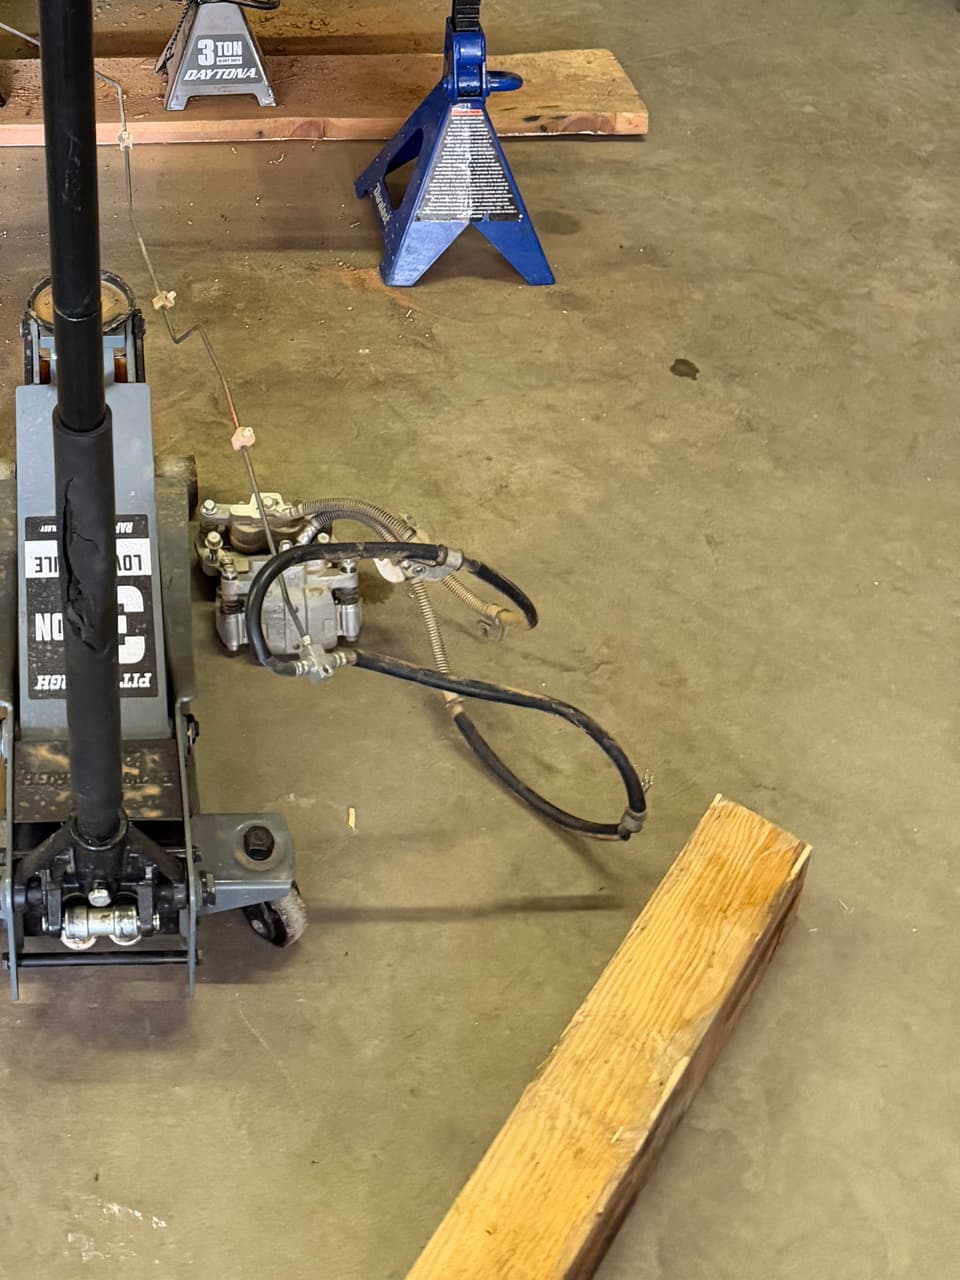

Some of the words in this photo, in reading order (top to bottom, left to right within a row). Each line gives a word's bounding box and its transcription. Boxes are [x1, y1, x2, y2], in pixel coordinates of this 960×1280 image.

[197, 39, 215, 66] 3
[216, 40, 243, 56] TON
[183, 67, 258, 81] DAYTONA
[117, 554, 143, 571] LO
[35, 612, 65, 641] ON
